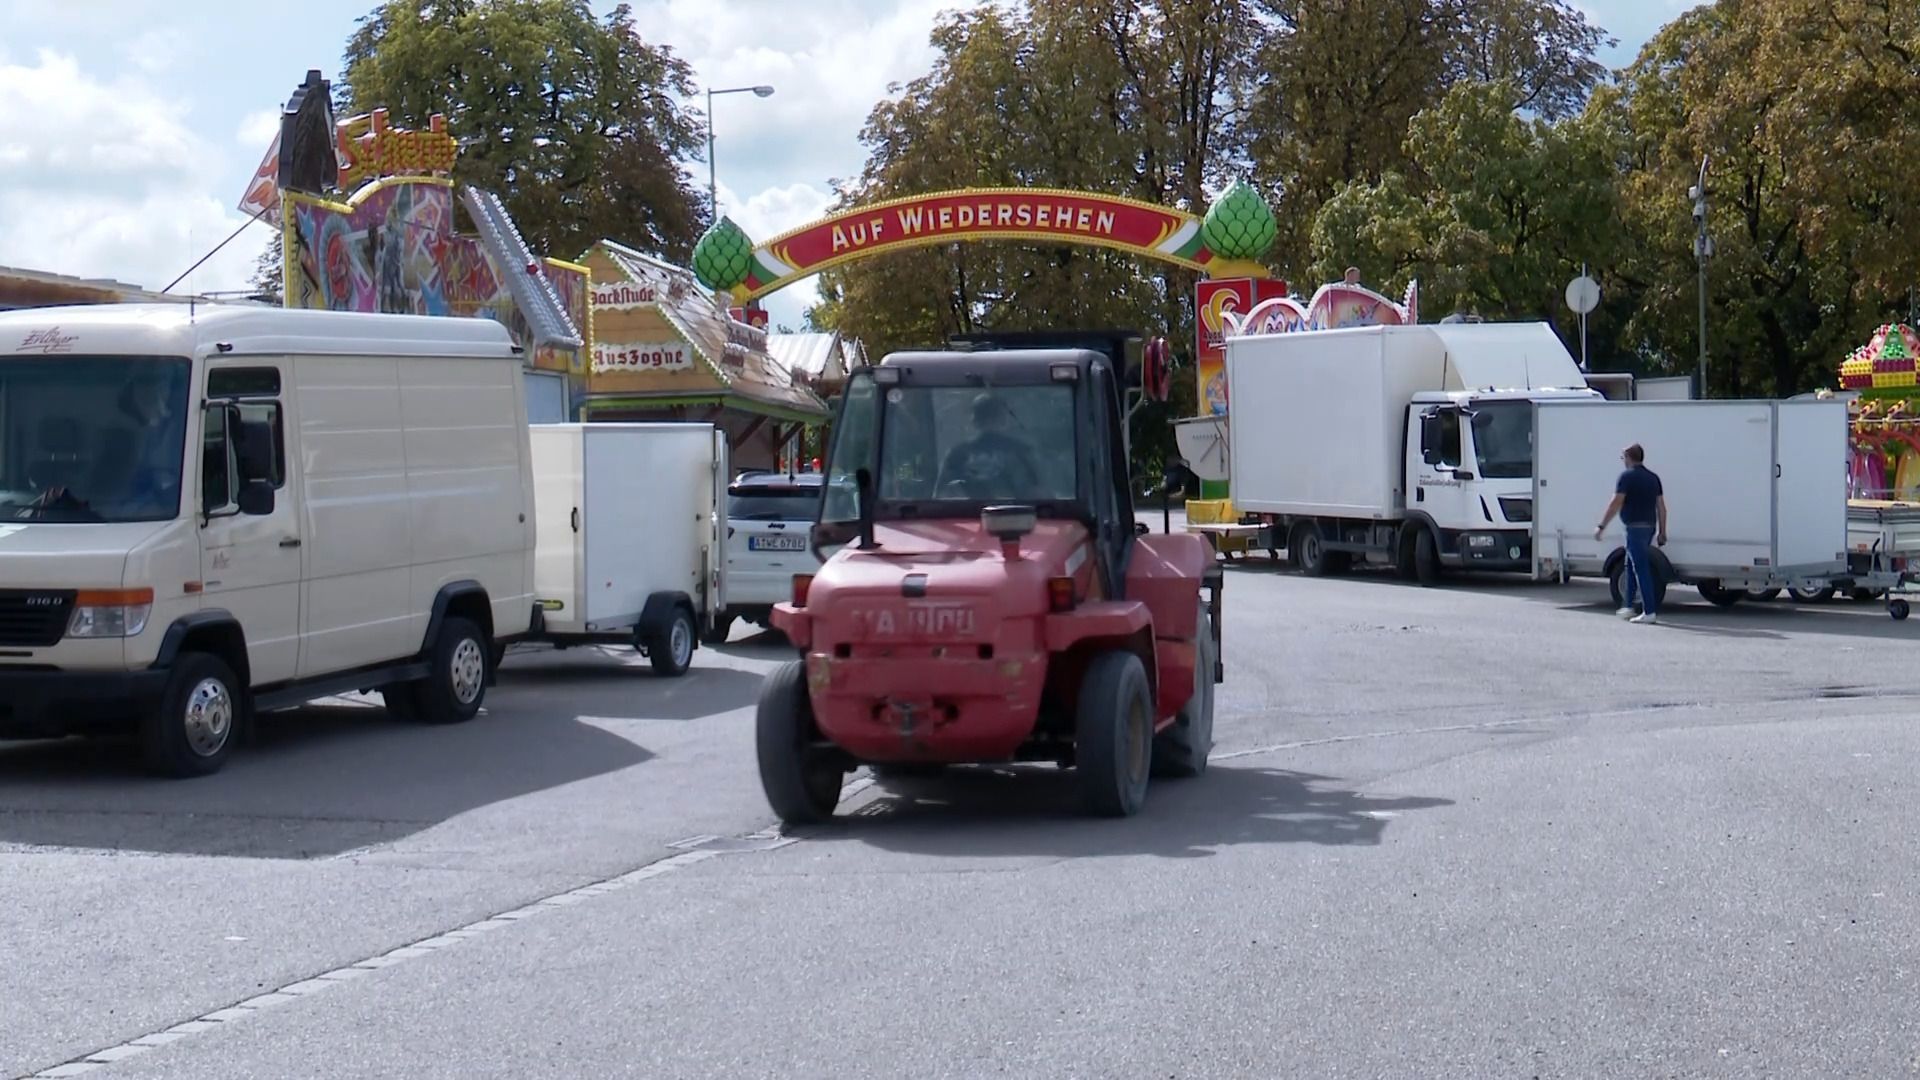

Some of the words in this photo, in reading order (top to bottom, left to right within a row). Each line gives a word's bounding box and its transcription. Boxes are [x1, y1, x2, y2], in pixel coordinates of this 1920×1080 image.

[831, 217, 885, 253] AUF
[896, 203, 1116, 236] WIEDERSEHEN
[767, 522, 786, 530] Jeep
